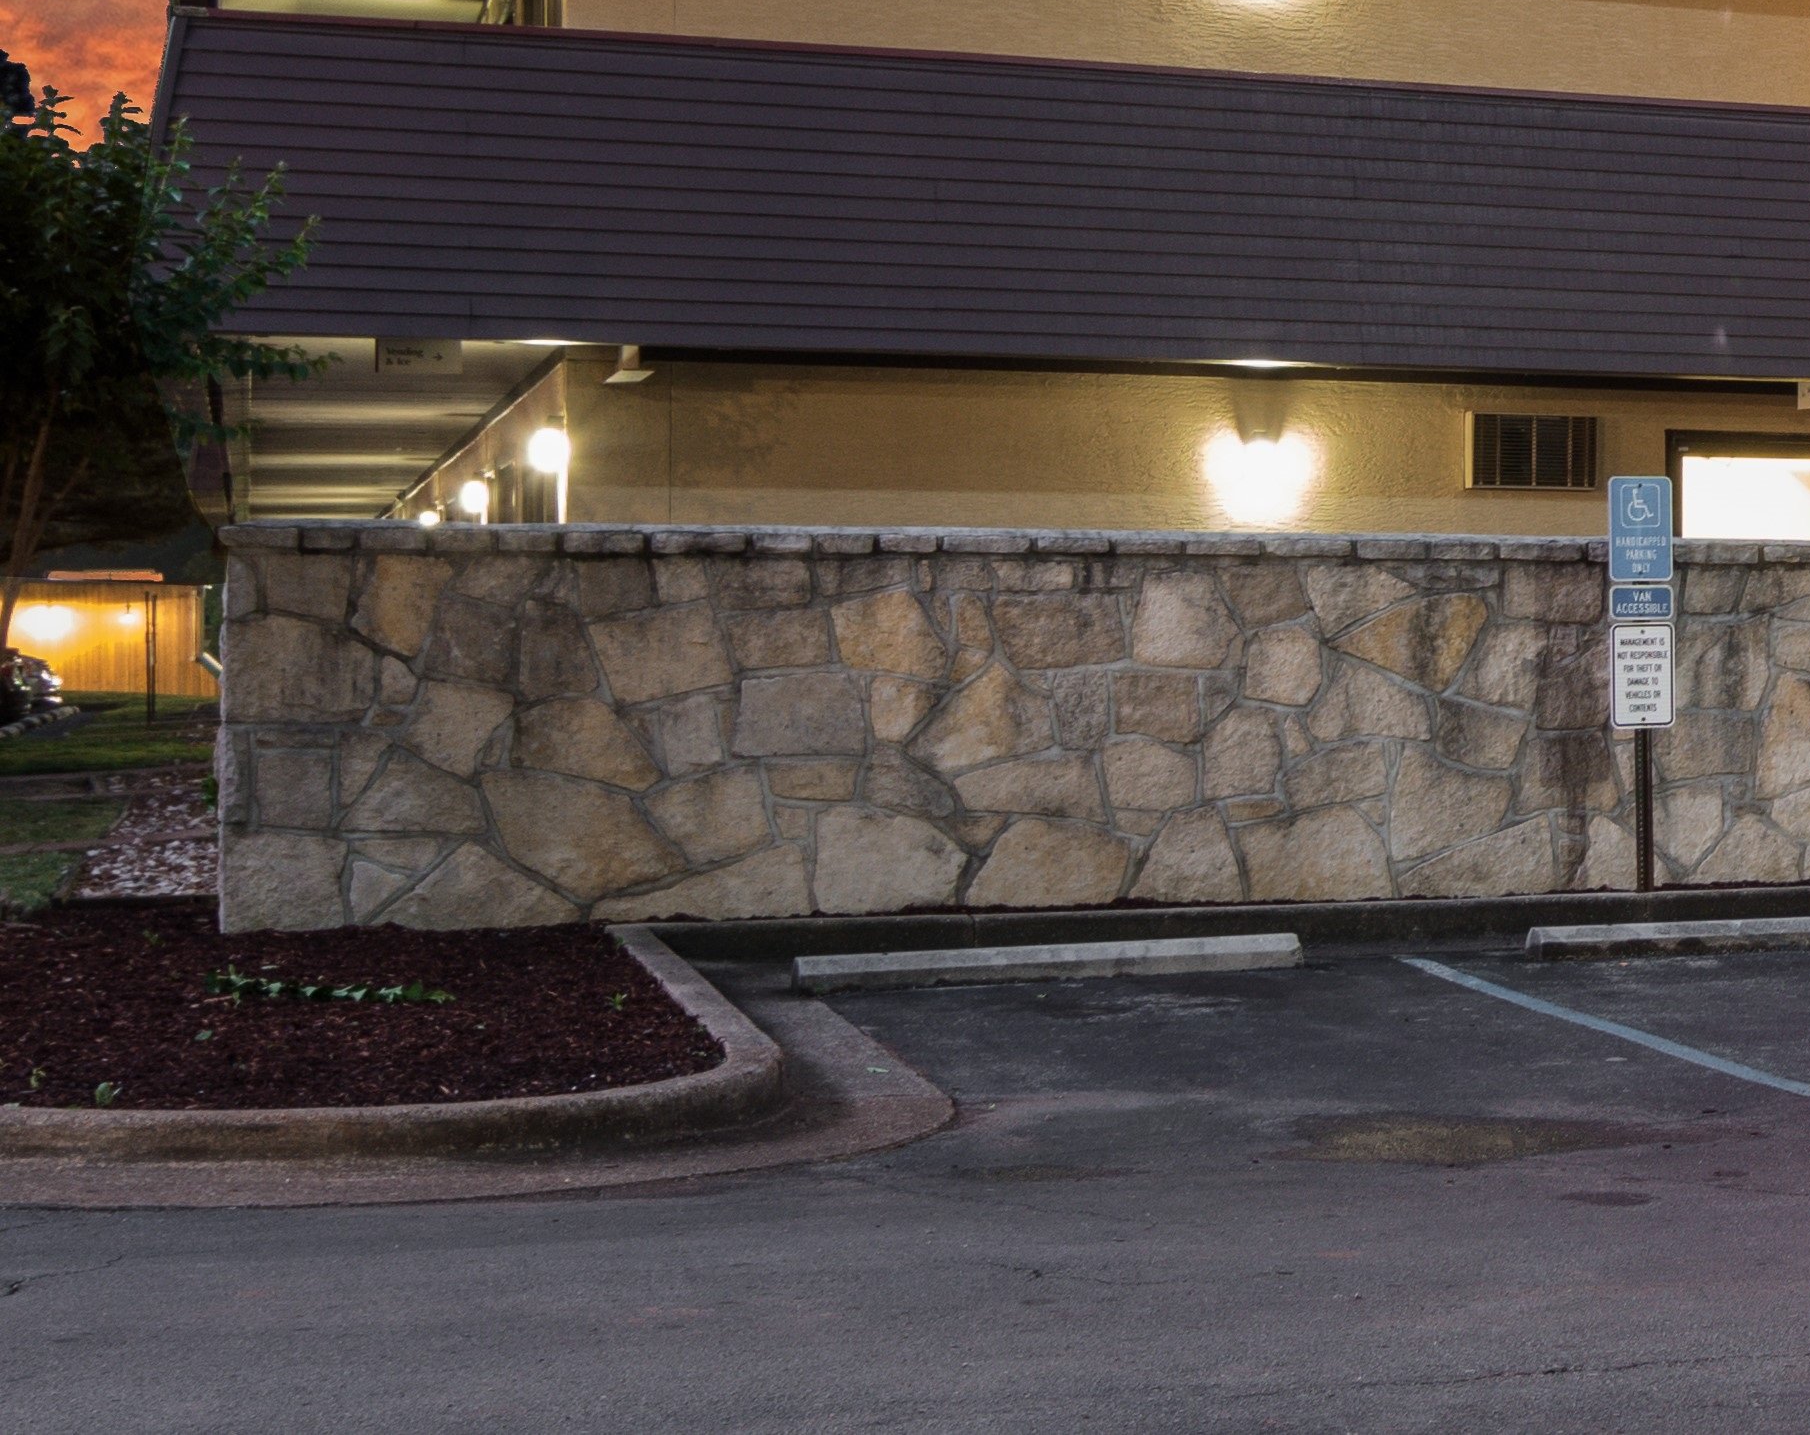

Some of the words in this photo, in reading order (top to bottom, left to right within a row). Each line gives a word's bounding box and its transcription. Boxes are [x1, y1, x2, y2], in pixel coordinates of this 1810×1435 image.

[1615, 536, 1667, 546] HANDICAPPED
[1626, 549, 1657, 560] PARKING
[1632, 562, 1651, 573] ONLY
[1632, 591, 1652, 602] VAN
[1615, 603, 1668, 614] ACCESSIBLE
[1620, 638, 1657, 646] MANAGEMENT
[1659, 637, 1665, 646] IS
[1617, 651, 1628, 660] NOT
[1630, 650, 1668, 659] RESPONSIBLE
[1623, 664, 1634, 673] FOR
[1636, 664, 1652, 673] THEFT
[1654, 664, 1662, 672] OR
[1627, 677, 1650, 686] DAMAGE
[1651, 676, 1659, 685] TO
[1625, 690, 1652, 699] VEHICLES
[1653, 689, 1661, 698] OR
[1629, 703, 1657, 712] CONTENTS
